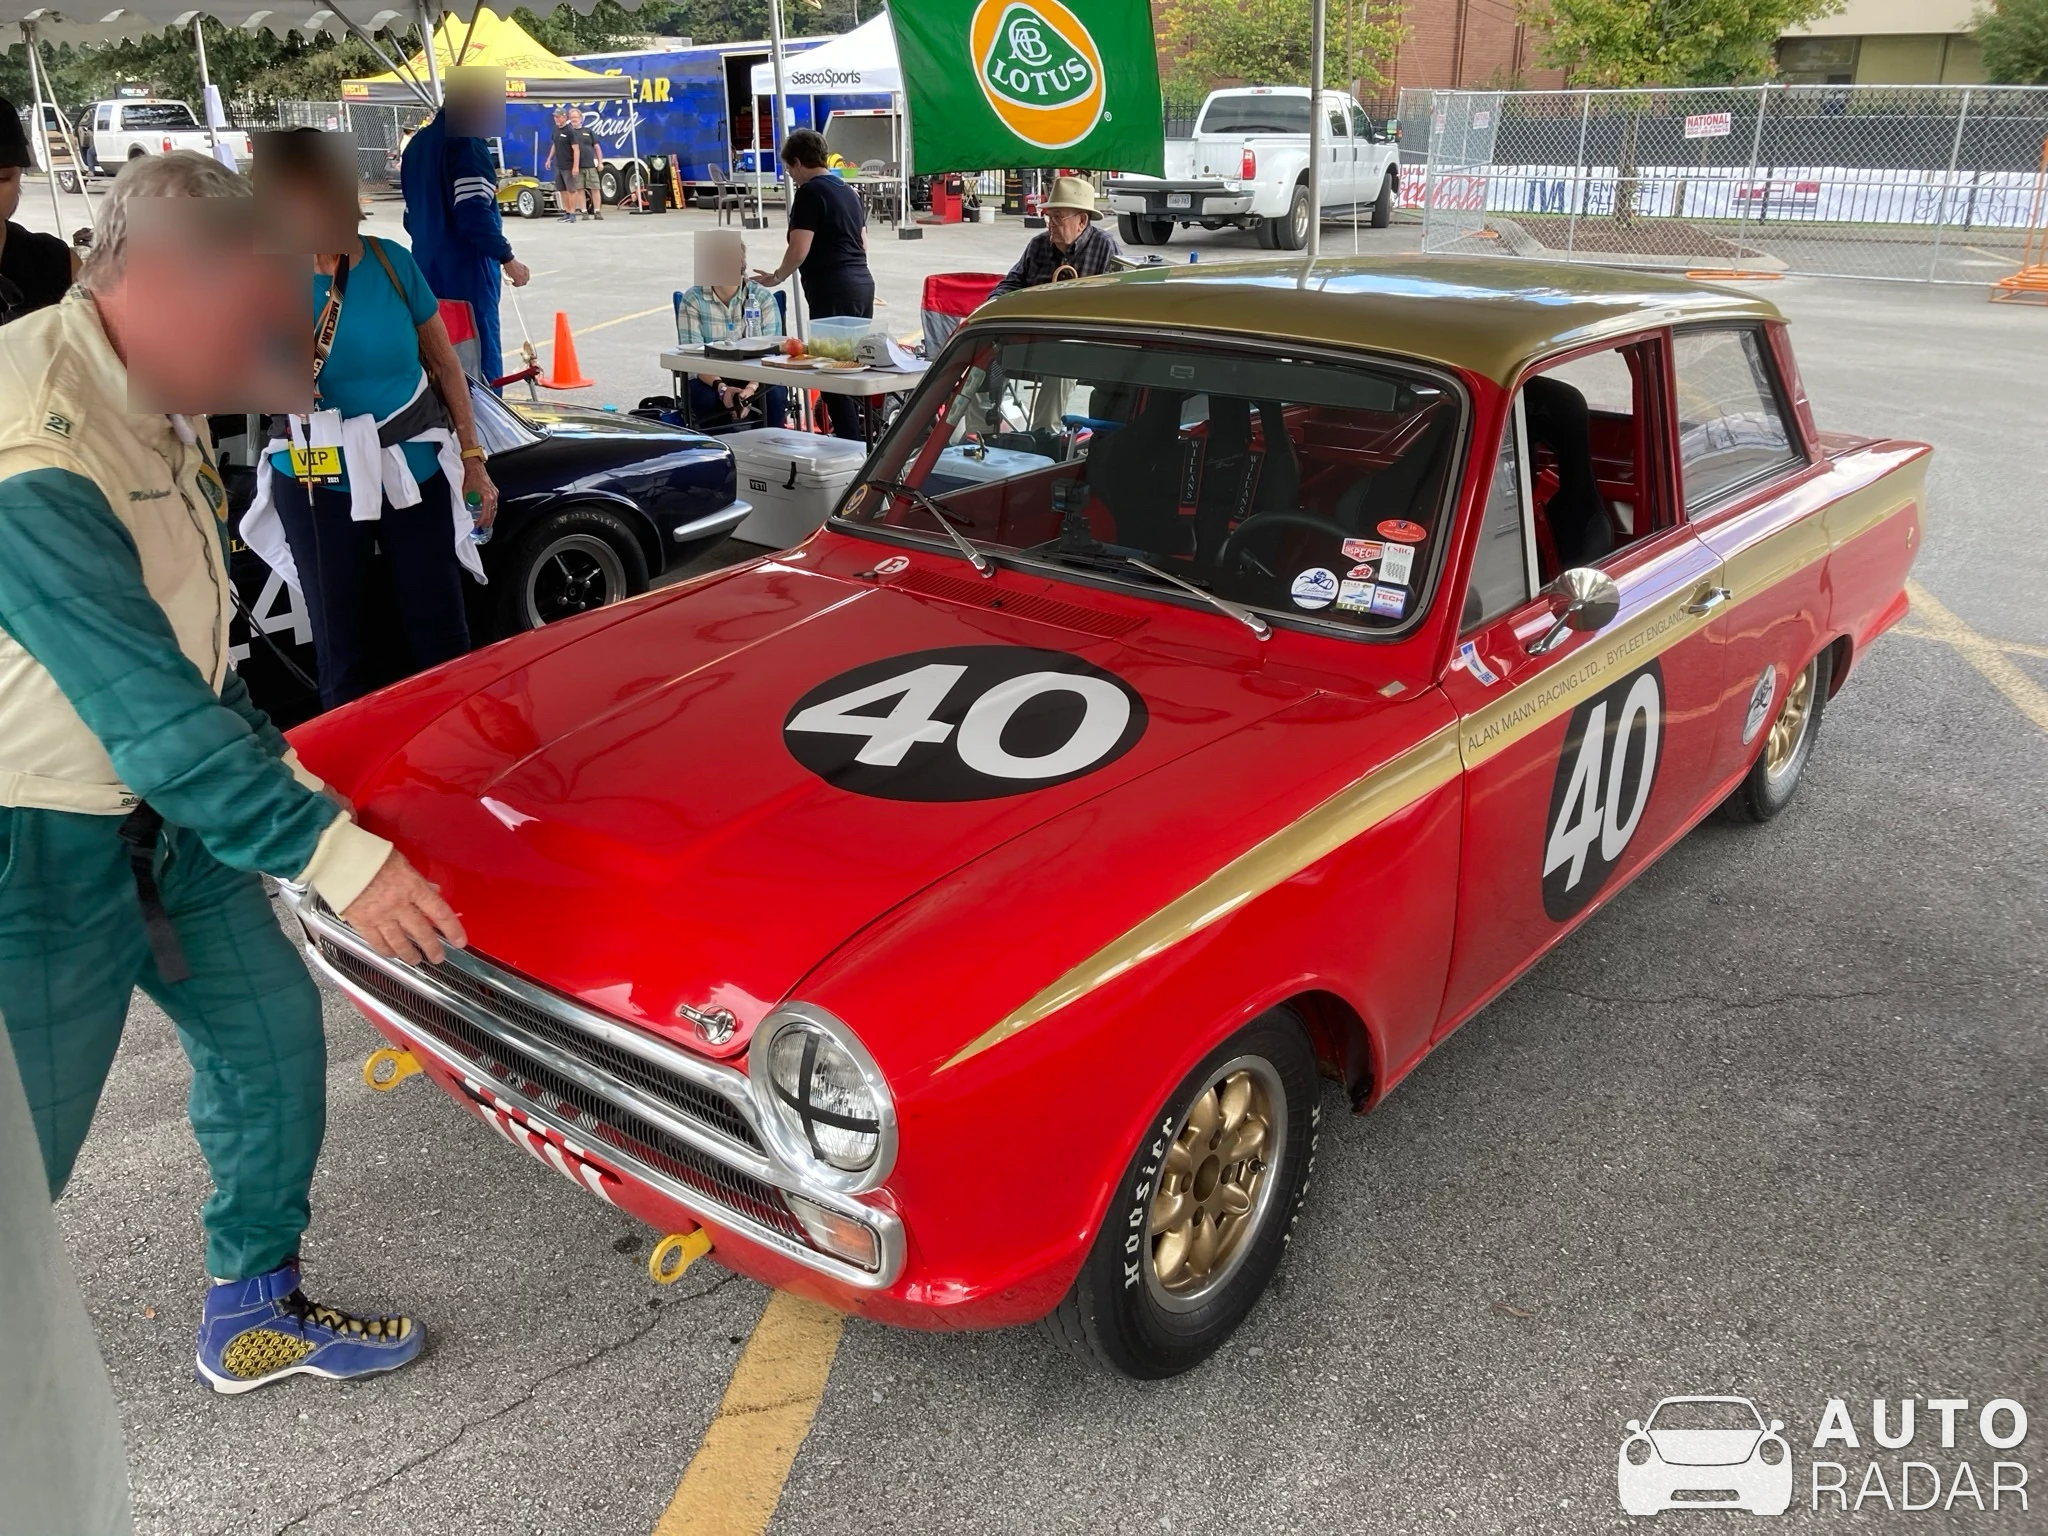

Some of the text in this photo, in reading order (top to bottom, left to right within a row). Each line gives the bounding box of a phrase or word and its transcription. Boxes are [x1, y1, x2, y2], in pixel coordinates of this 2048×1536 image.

[791, 68, 861, 88] SascoSports
[992, 57, 1087, 96] LOTUS
[1687, 113, 1729, 128] NATIONAL
[1527, 178, 1565, 214] TVA
[320, 300, 340, 346] MECUM
[297, 451, 328, 467] VIP
[1187, 440, 1202, 499] WILLANS
[749, 479, 767, 492] YETI
[1239, 455, 1259, 514] WILLANS
[1341, 603, 1365, 612] TECH
[1377, 593, 1404, 605] TECH
[1468, 720, 1500, 752] ALAN
[1502, 702, 1537, 732] MANN
[1537, 676, 1578, 710] RACING
[1607, 629, 1648, 666] BYFLEET
[785, 663, 1131, 779] 40
[1542, 672, 1660, 893] 40
[1124, 1116, 1173, 1290] Hoosier
